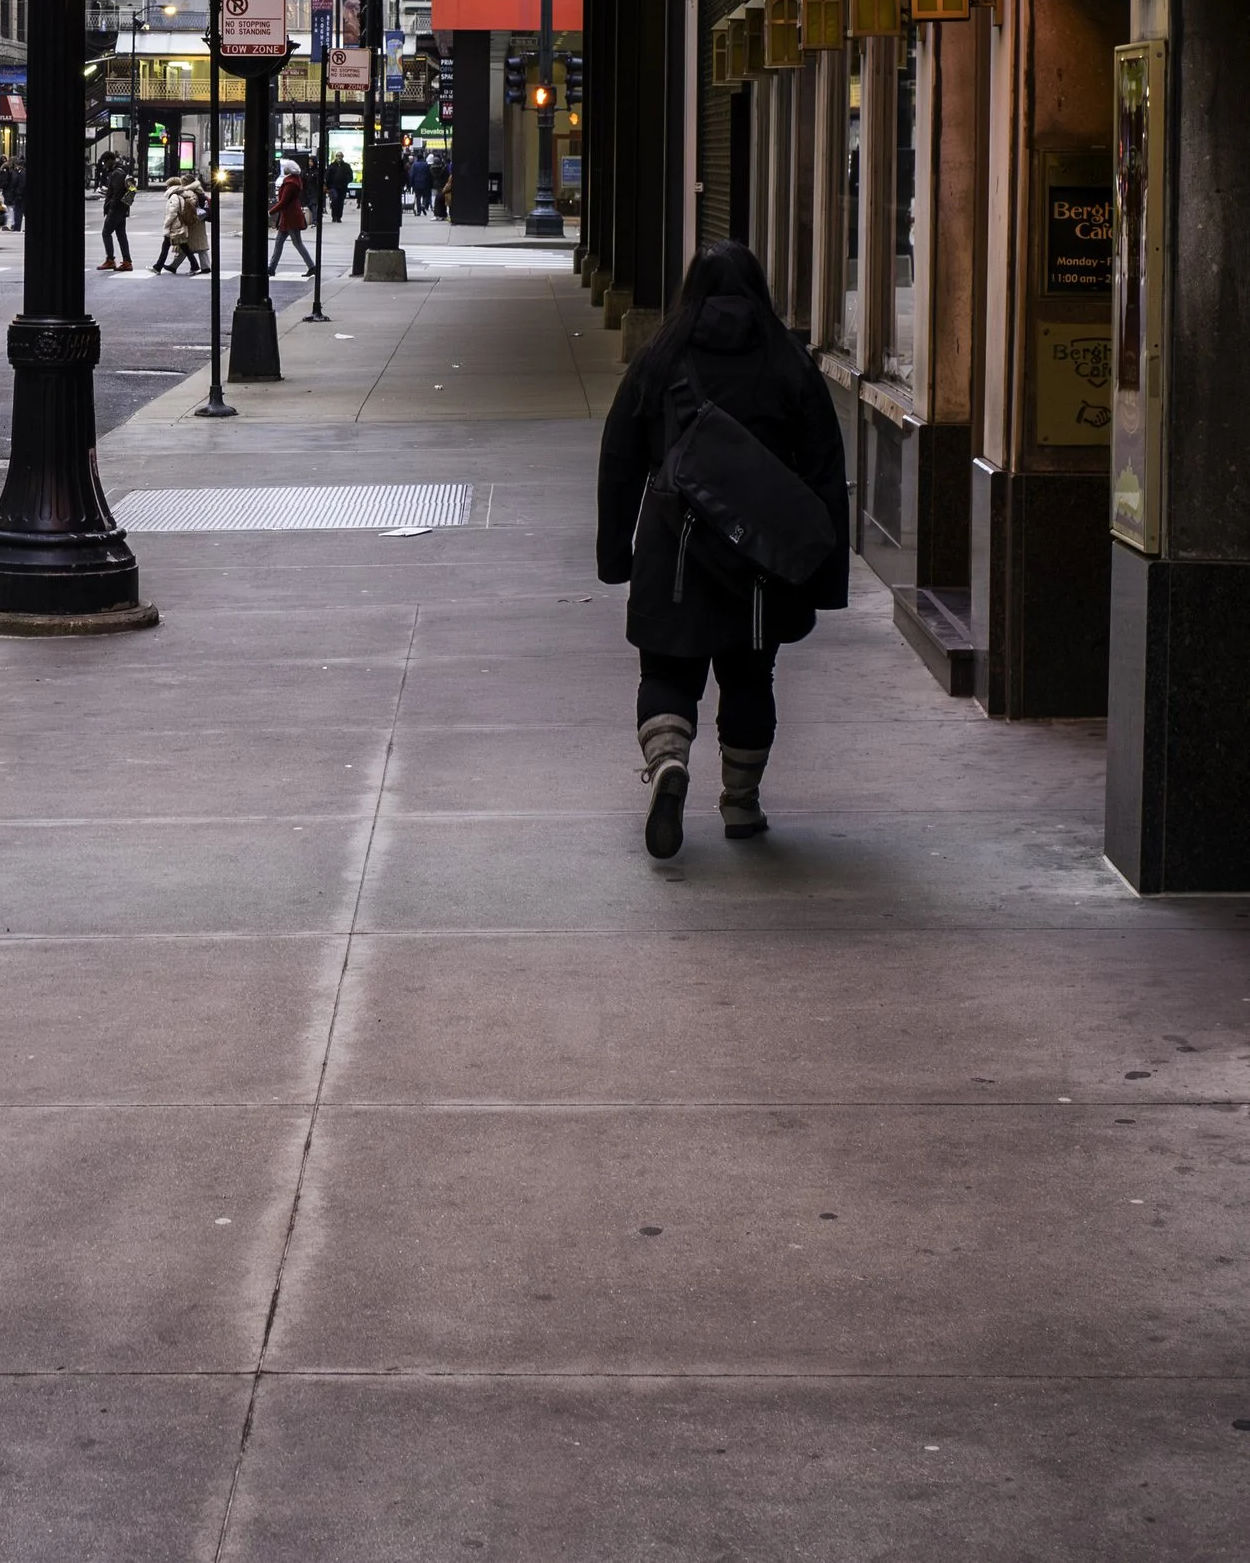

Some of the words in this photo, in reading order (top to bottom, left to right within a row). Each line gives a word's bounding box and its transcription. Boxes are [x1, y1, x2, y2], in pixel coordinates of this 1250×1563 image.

[225, 45, 247, 54] TOW
[252, 45, 280, 54] ZONE
[1057, 256, 1098, 268] Monday
[1079, 275, 1096, 284] am
